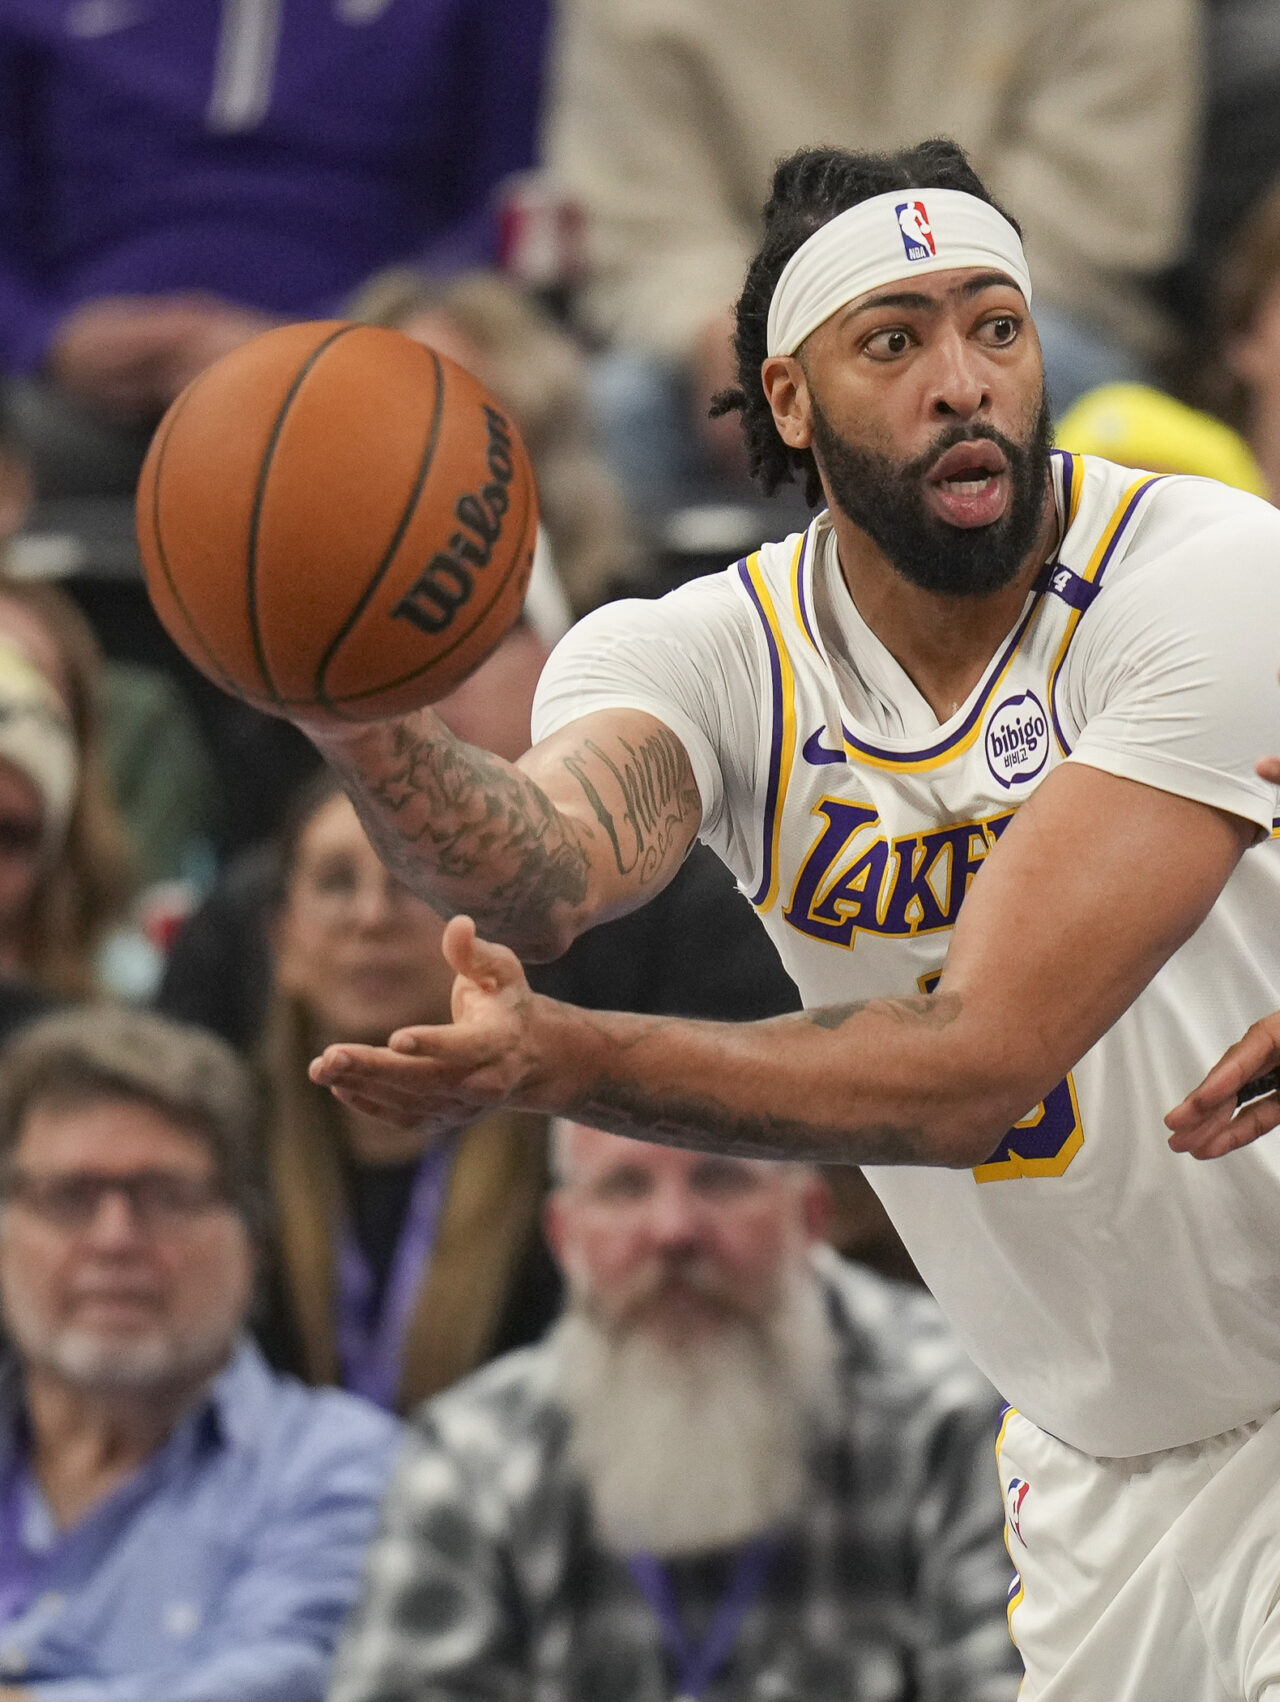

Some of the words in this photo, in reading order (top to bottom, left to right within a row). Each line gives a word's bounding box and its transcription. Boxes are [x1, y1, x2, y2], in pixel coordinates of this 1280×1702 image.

[909, 246, 926, 260] NBA
[389, 404, 514, 634] Wilson
[990, 715, 1045, 758] bibigo
[1003, 747, 1029, 768] 비비고
[782, 794, 1021, 951] LAKE
